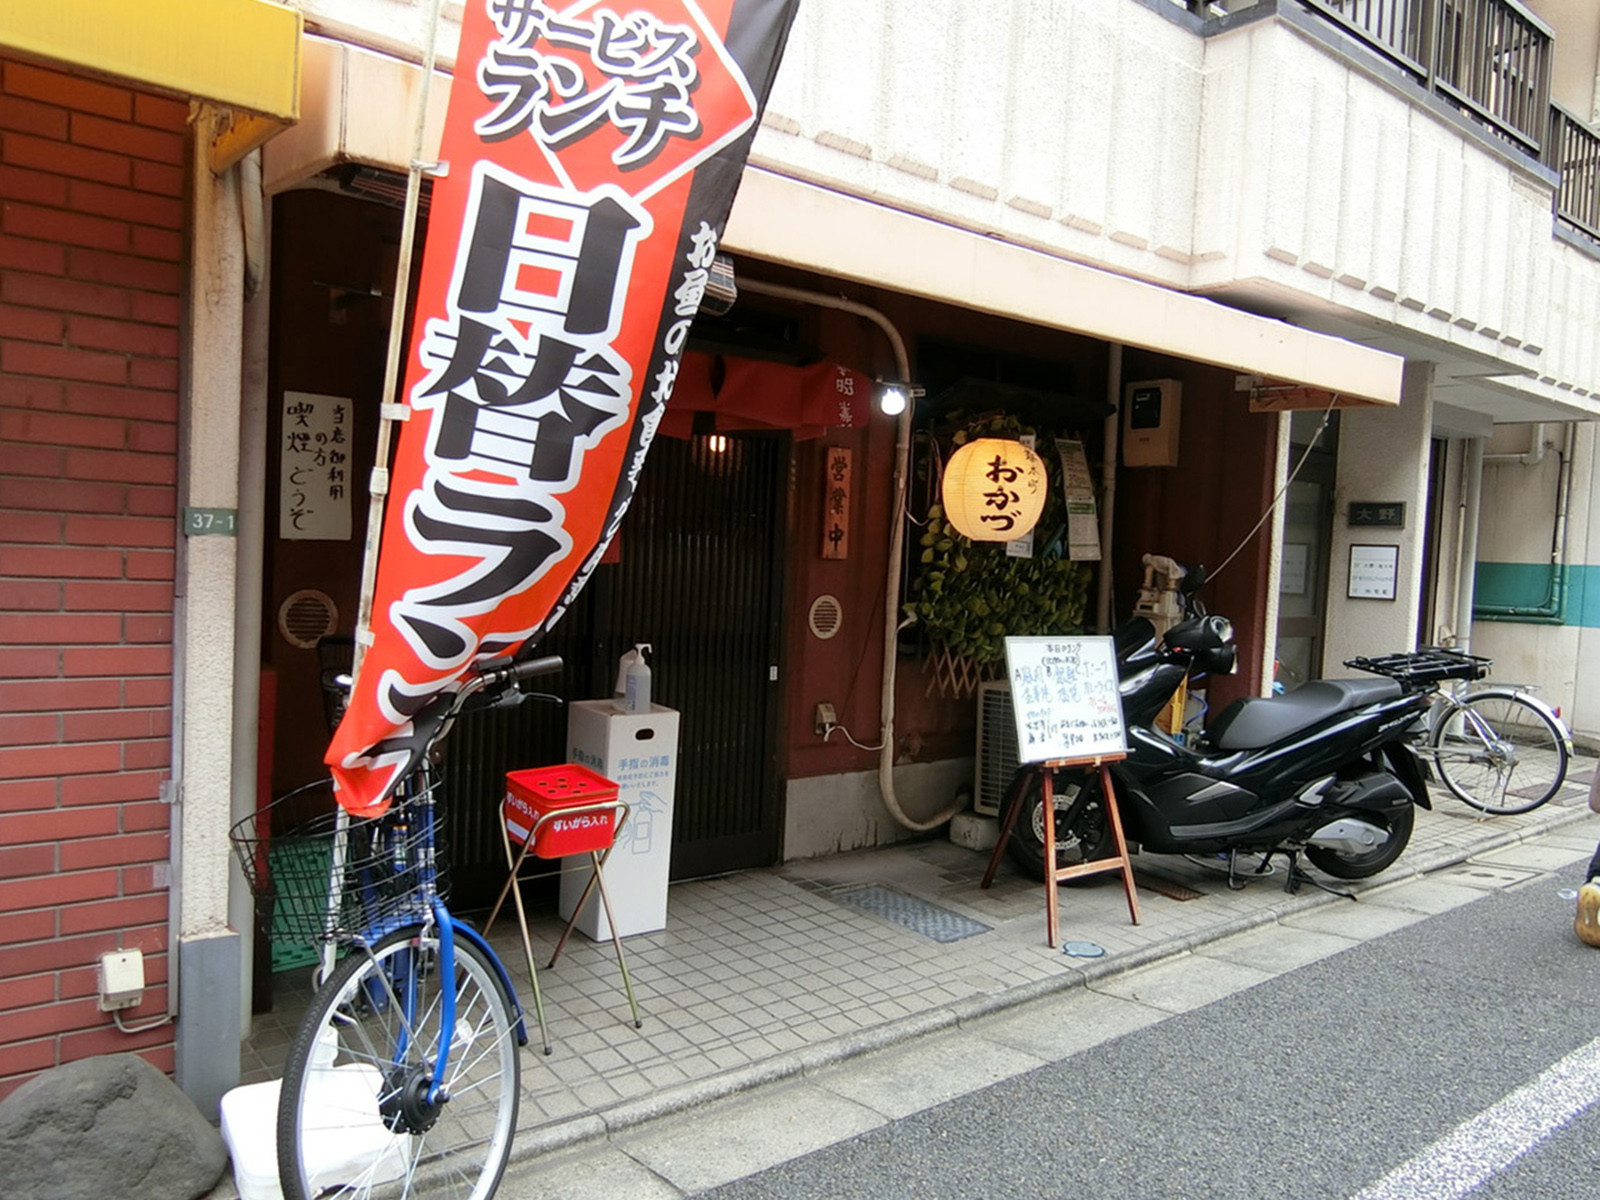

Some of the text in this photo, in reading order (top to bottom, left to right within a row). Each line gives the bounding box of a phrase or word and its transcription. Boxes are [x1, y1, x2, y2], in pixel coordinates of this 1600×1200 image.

[488, 0, 698, 86] サービス
[474, 46, 702, 172] ランチ
[286, 401, 314, 531] 喫煙どうぞ
[313, 432, 328, 467] の方
[980, 454, 1025, 531] おかづ
[192, 513, 234, 530] 37-1
[1356, 508, 1396, 520] 大野
[618, 755, 670, 771] 手指の消毒
[553, 815, 609, 833] すいがら入れ
